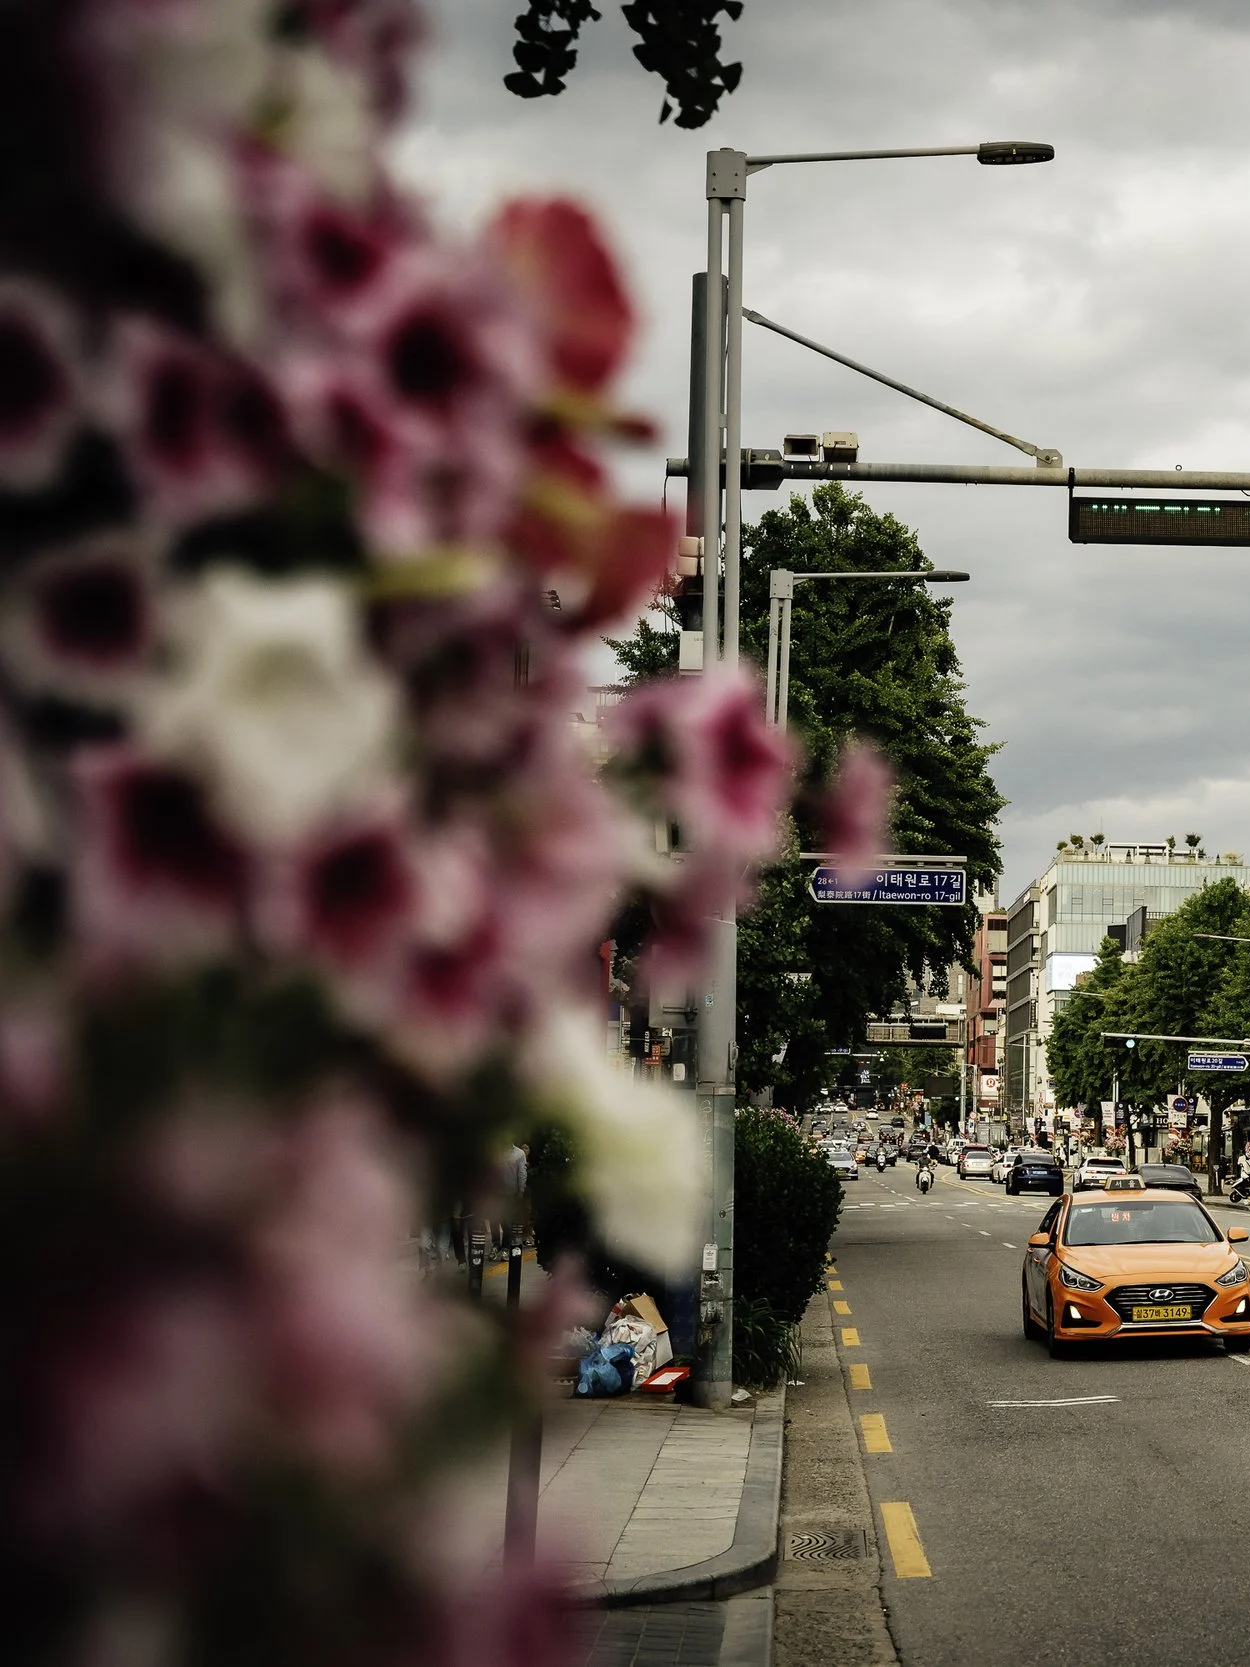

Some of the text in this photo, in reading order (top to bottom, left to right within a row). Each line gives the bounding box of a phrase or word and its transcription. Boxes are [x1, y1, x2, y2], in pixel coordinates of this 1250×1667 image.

[876, 873, 961, 889] 이태원로17길
[879, 890, 931, 900] Itaewon-ro
[935, 891, 961, 902] 17-gil
[1163, 1307, 1188, 1318] 3149
